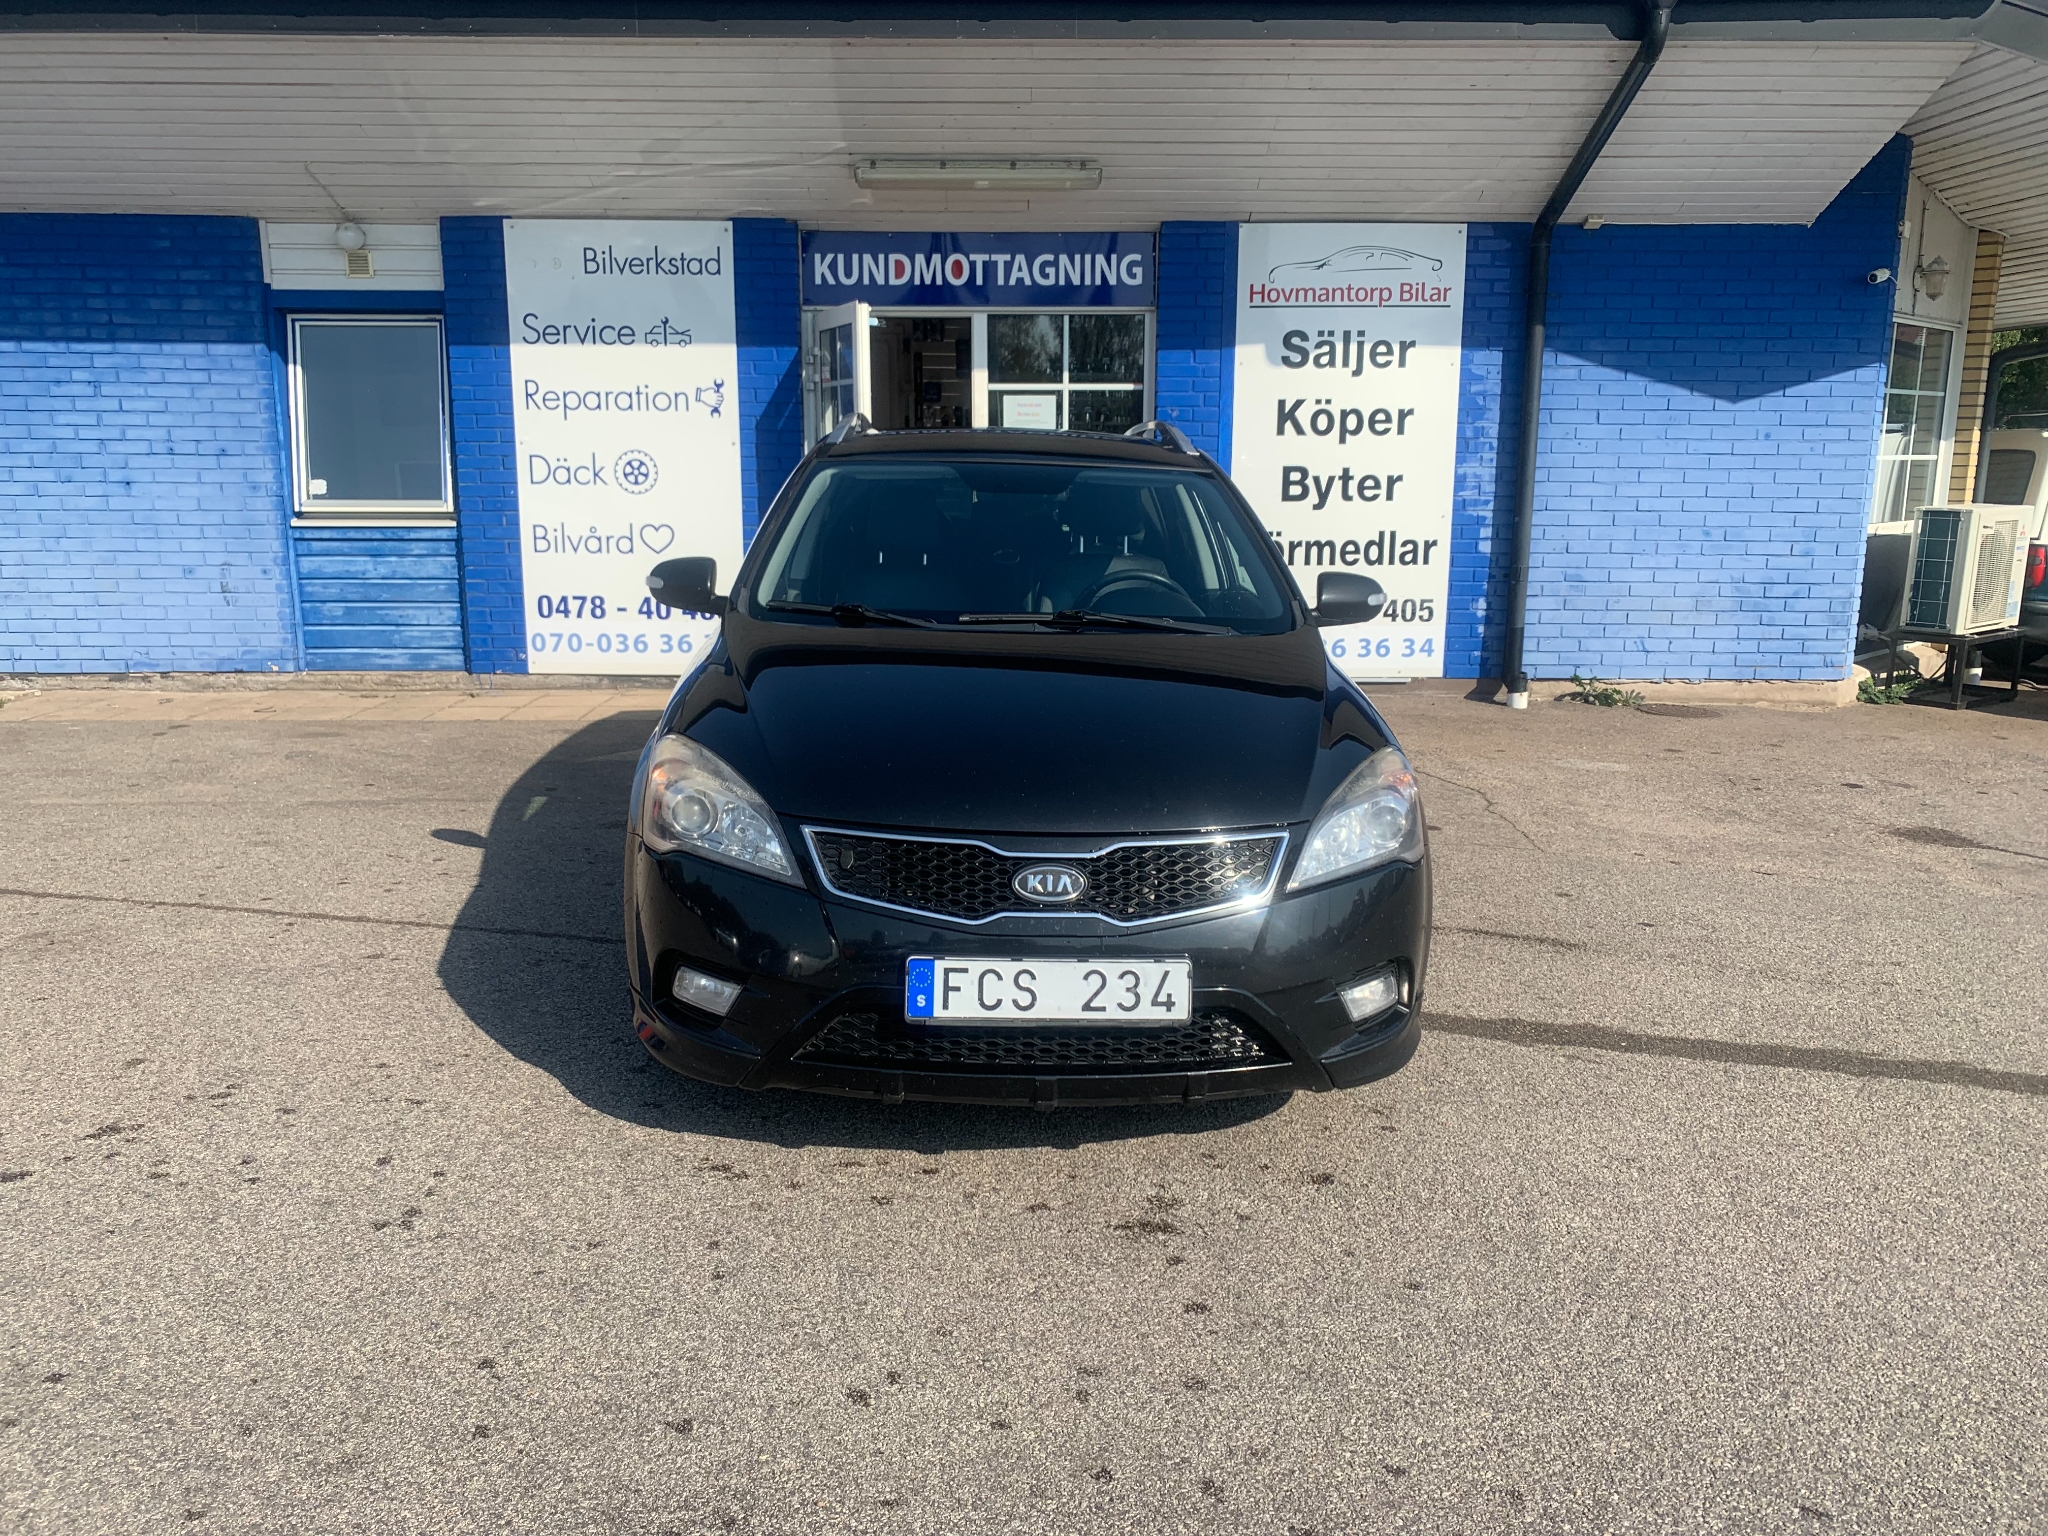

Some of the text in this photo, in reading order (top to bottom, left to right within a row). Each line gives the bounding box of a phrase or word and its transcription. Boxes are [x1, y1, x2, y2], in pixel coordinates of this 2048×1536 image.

[582, 245, 722, 276] Bilverkstad
[813, 252, 1144, 287] KUNDMOTTAGNING
[1249, 281, 1452, 308] Hovmantorp Bilar
[521, 312, 636, 346] Service
[1281, 329, 1416, 377] Säljer
[524, 379, 690, 420] Reparation
[1276, 398, 1414, 445] Köper
[528, 452, 609, 486] Däck
[1281, 465, 1404, 511] Byter
[532, 521, 635, 555] Bilvård
[537, 594, 607, 620] 0478
[1382, 598, 1435, 623] 405
[531, 632, 693, 654] 070-036 36
[1357, 637, 1391, 658] 36
[1401, 637, 1435, 658] 34
[1026, 873, 1075, 894] KIA
[916, 994, 927, 1008] S
[942, 967, 1177, 1013] FCS 234
